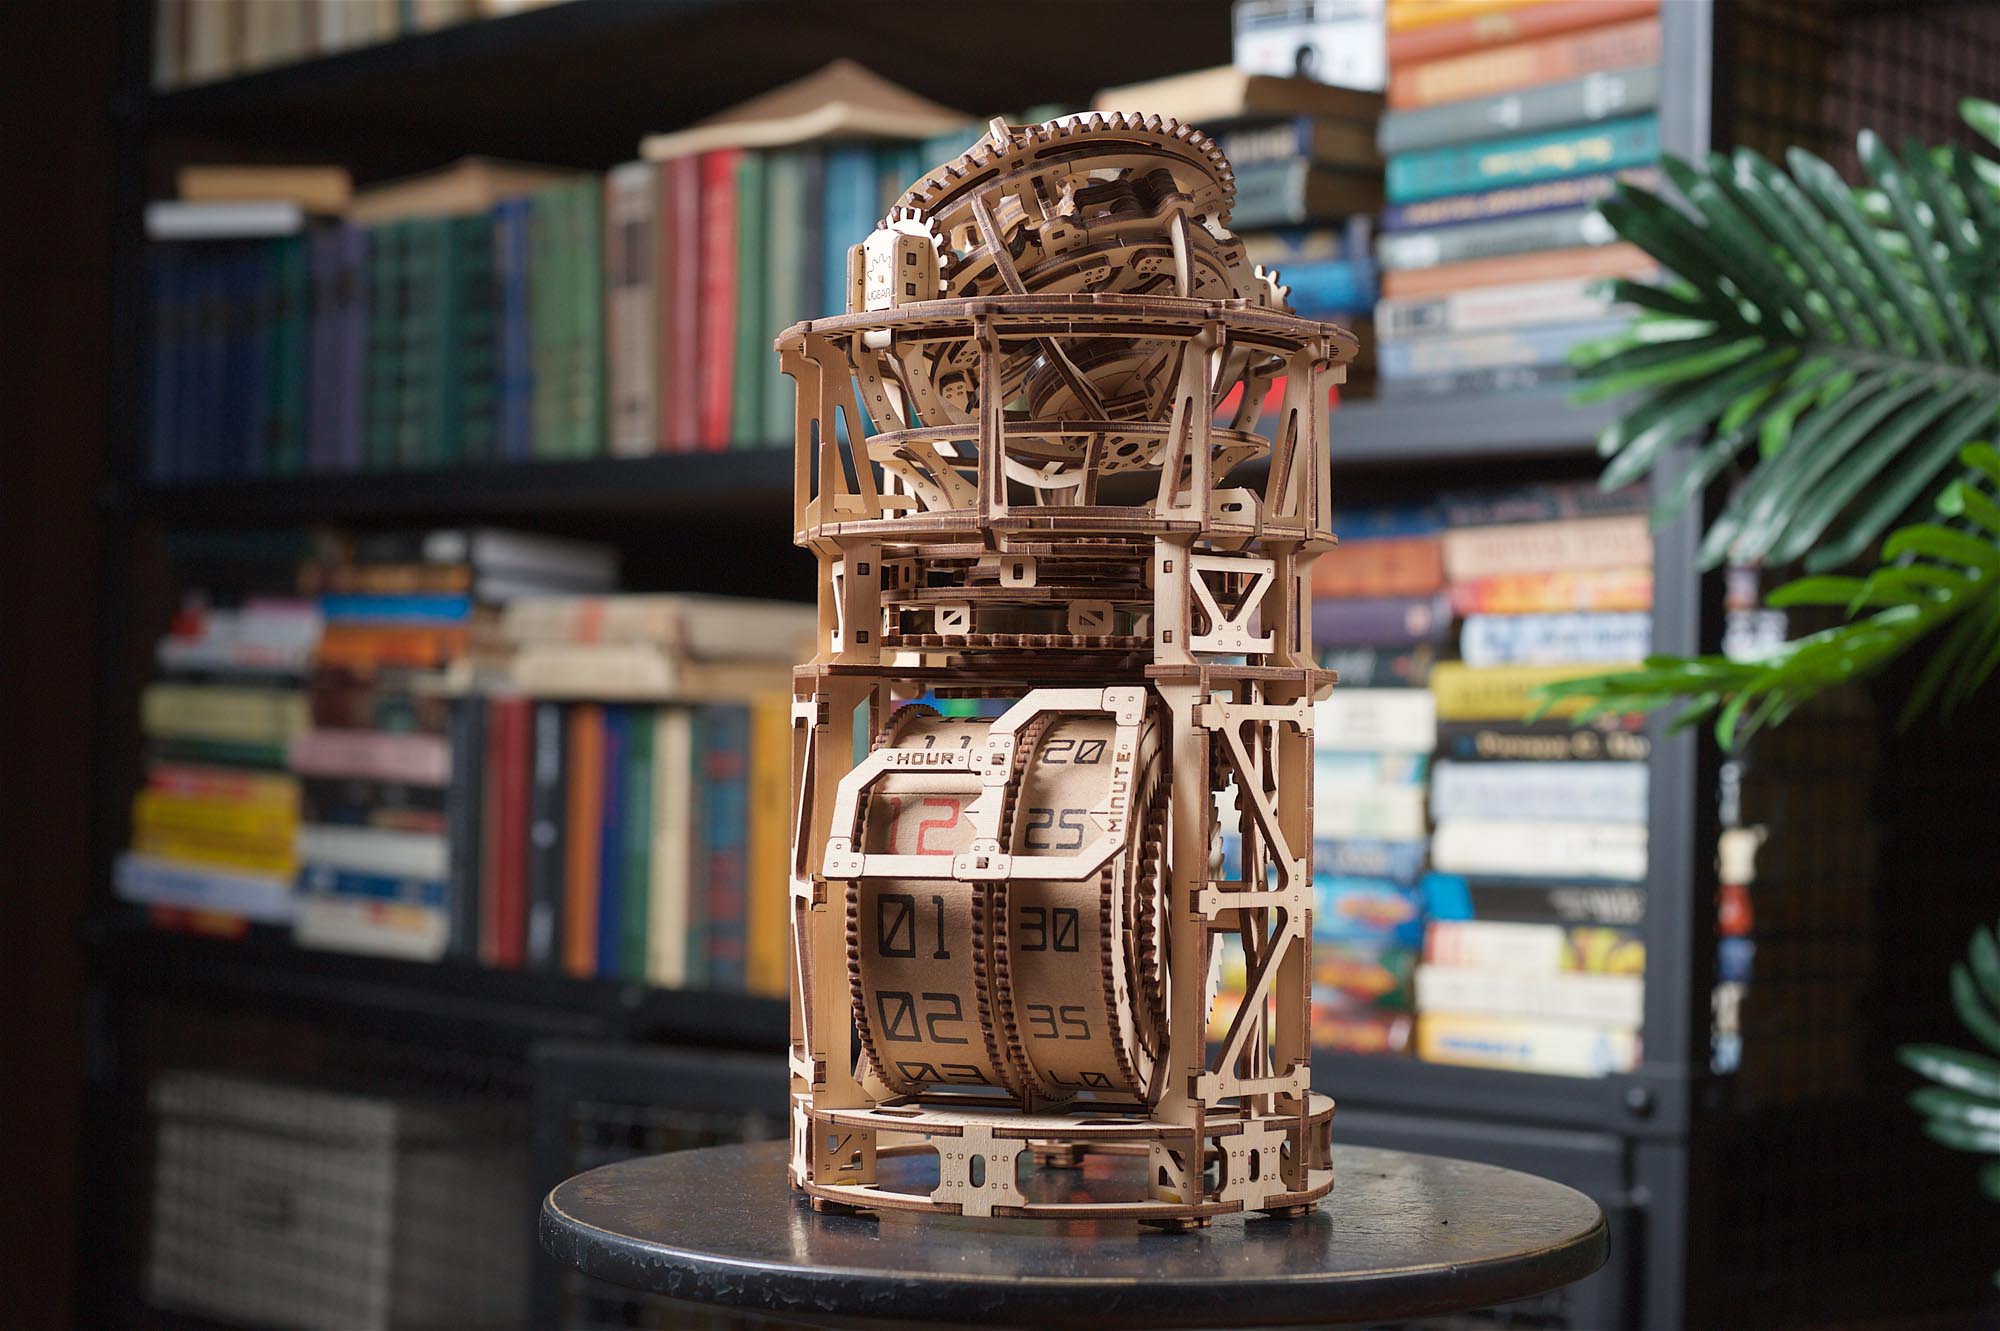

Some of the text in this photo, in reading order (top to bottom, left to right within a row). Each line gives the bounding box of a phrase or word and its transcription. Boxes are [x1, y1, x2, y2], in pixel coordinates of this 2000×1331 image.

[896, 752, 954, 766] HOUR
[1042, 739, 1107, 765] 20
[1107, 752, 1131, 833] MINUTE
[888, 796, 961, 856] 12
[1023, 808, 1087, 850] 25
[877, 893, 951, 960] 01
[1019, 906, 1080, 953] 30
[876, 991, 969, 1045] 02
[1027, 1004, 1091, 1041] 35
[895, 1061, 993, 1086] 03
